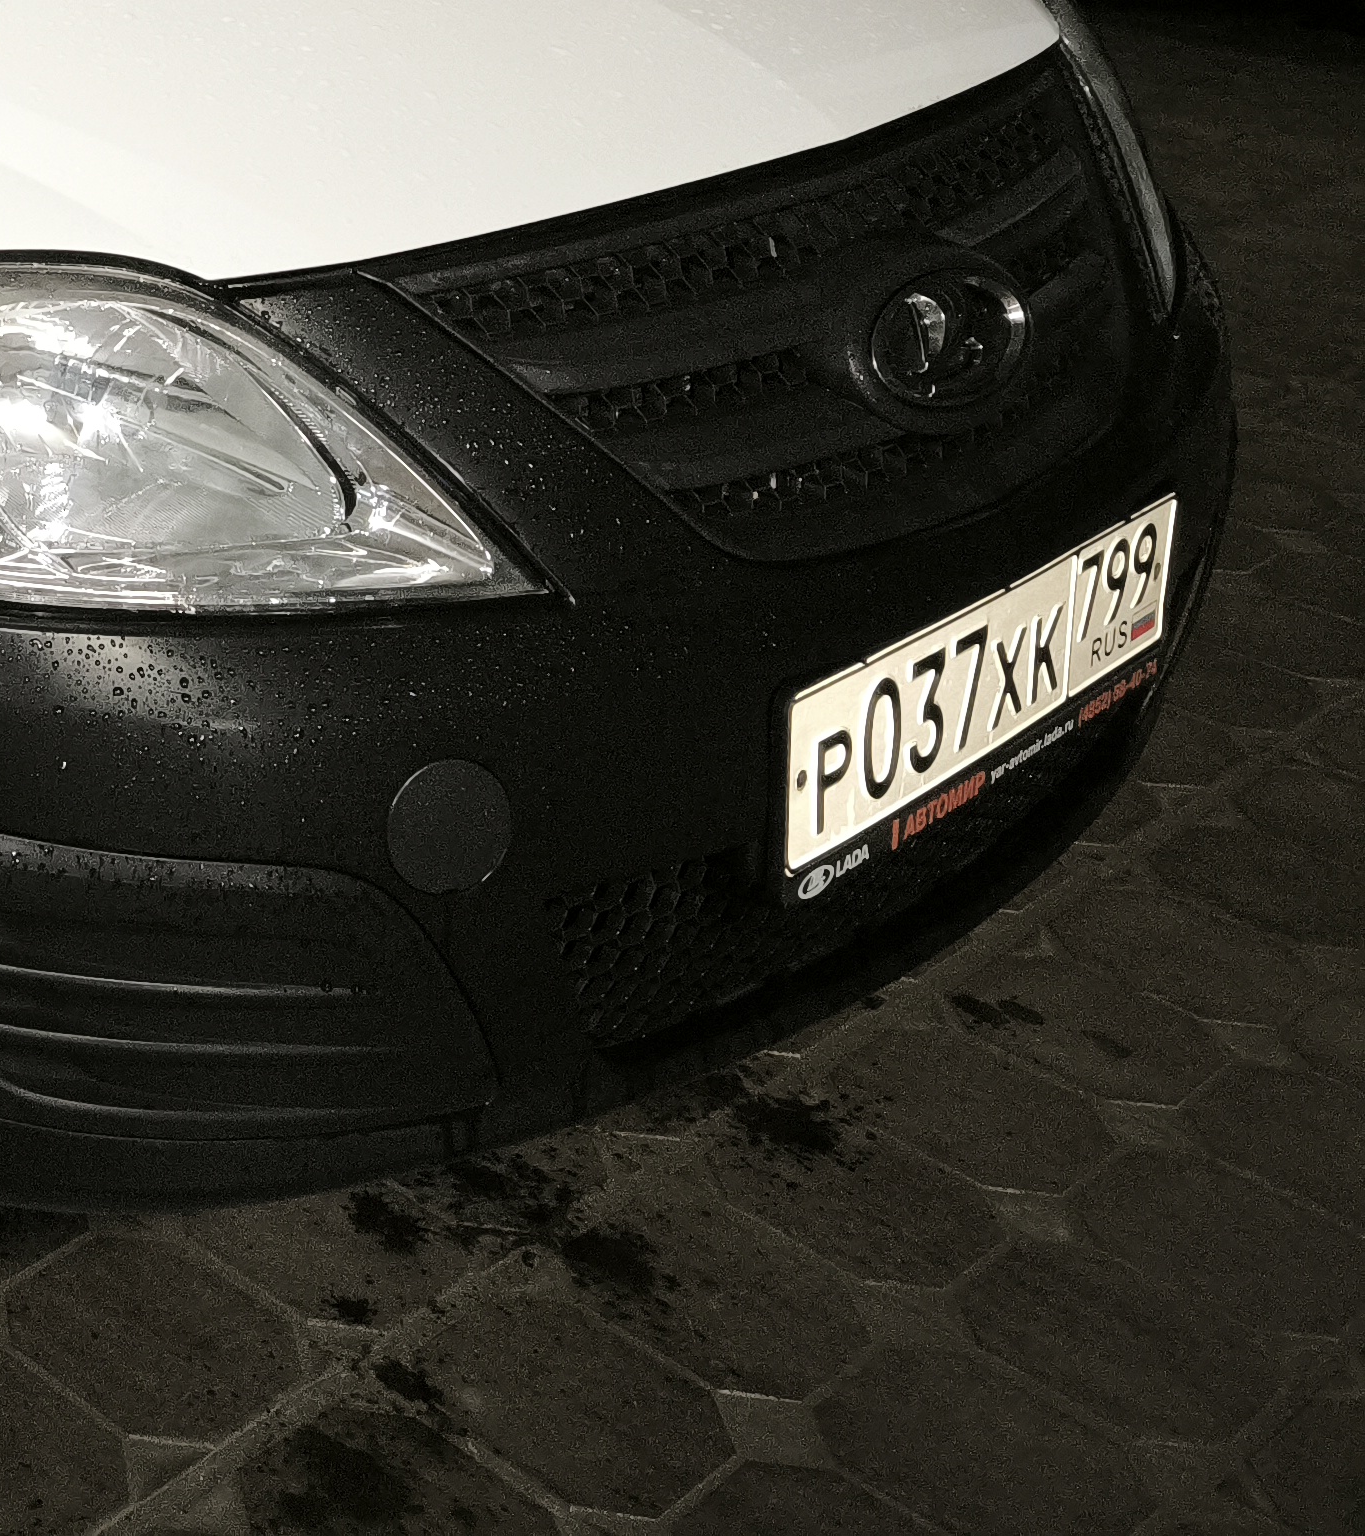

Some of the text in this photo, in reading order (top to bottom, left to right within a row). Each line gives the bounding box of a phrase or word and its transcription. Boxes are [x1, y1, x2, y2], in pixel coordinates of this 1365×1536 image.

[814, 522, 1157, 836] Р037ХК 799
[1089, 619, 1129, 668] RUS
[835, 843, 870, 878] LADA
[902, 770, 987, 844] АВТОМИР
